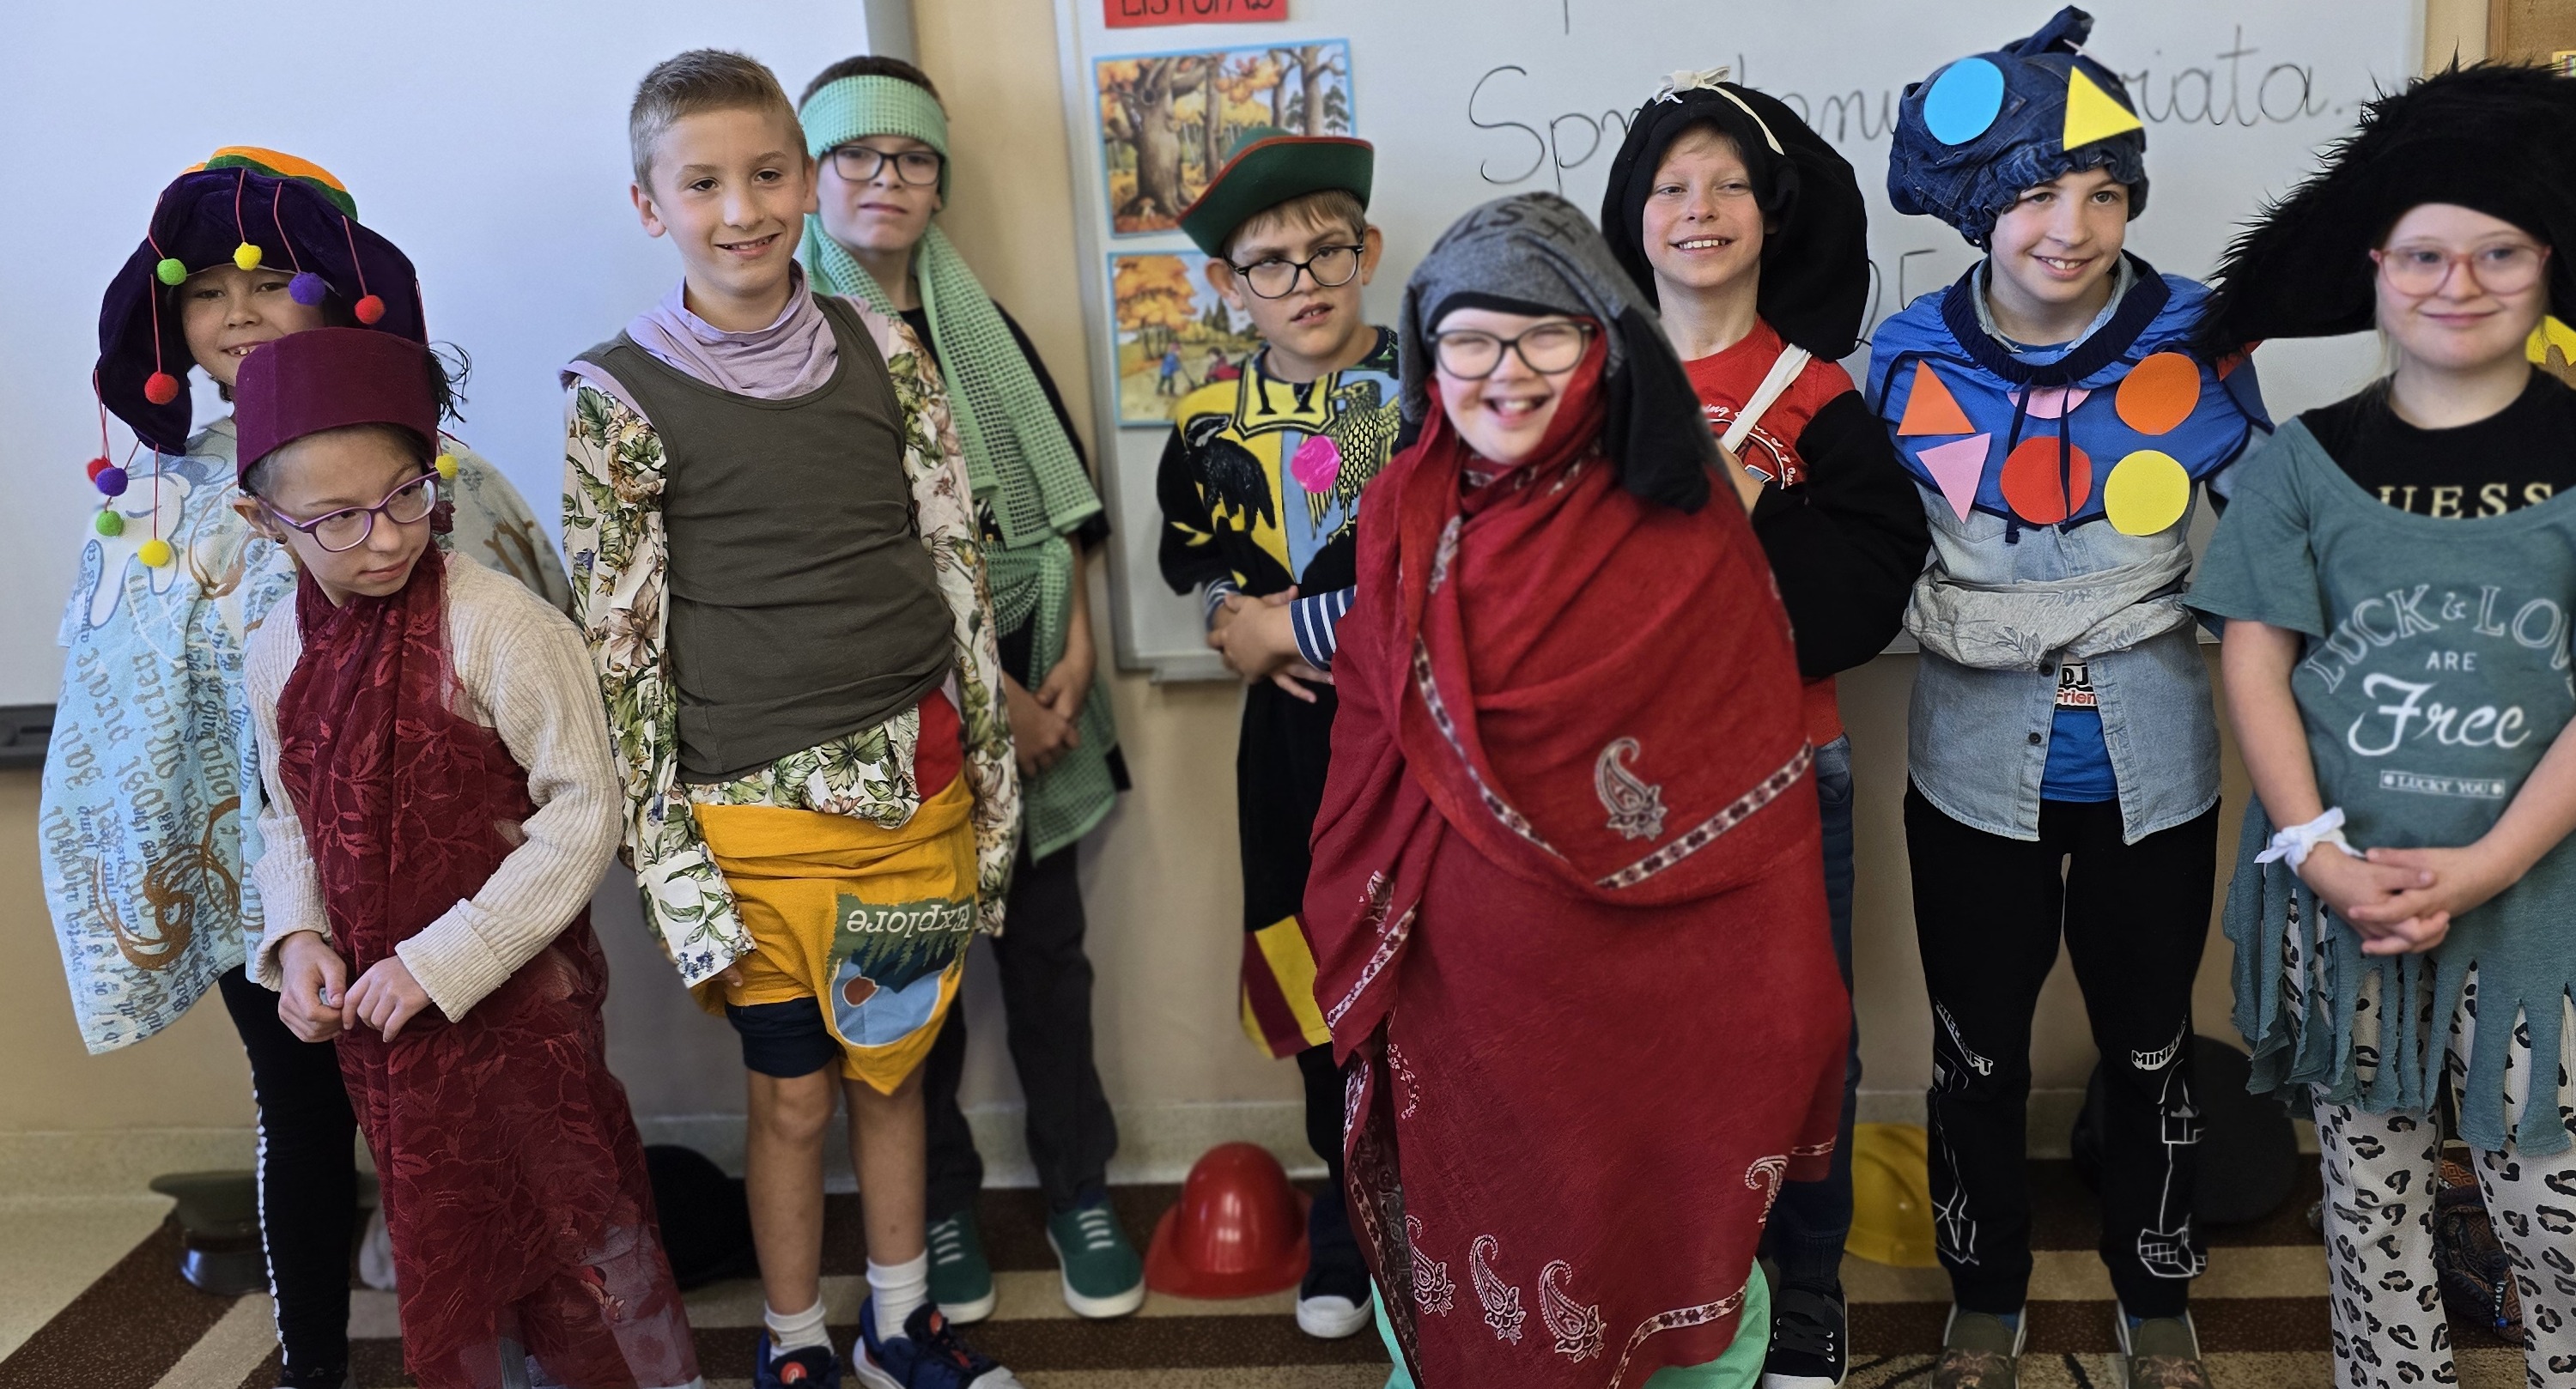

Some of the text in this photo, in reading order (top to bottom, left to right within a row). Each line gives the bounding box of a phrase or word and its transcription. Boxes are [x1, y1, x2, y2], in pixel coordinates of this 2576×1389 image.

[2305, 584, 2440, 694] LUCK
[2425, 651, 2477, 671] ARE
[2348, 672, 2532, 756] Free
[2397, 775, 2489, 796] LUCKY YOU
[846, 904, 970, 939] Explore
